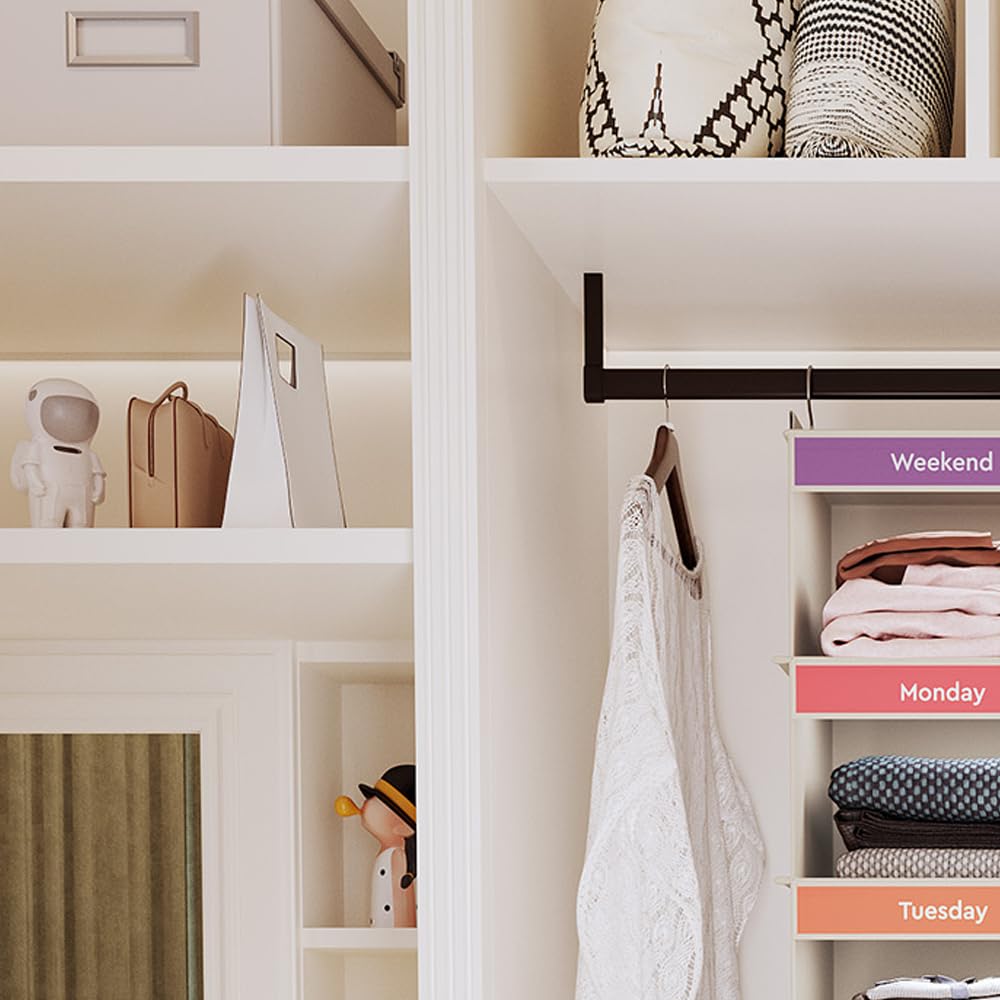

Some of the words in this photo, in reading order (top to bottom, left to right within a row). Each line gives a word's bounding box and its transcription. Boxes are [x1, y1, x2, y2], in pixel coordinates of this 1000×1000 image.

[891, 450, 993, 472] Weekend
[901, 680, 986, 706] Monday
[898, 899, 989, 925] Tuesday
